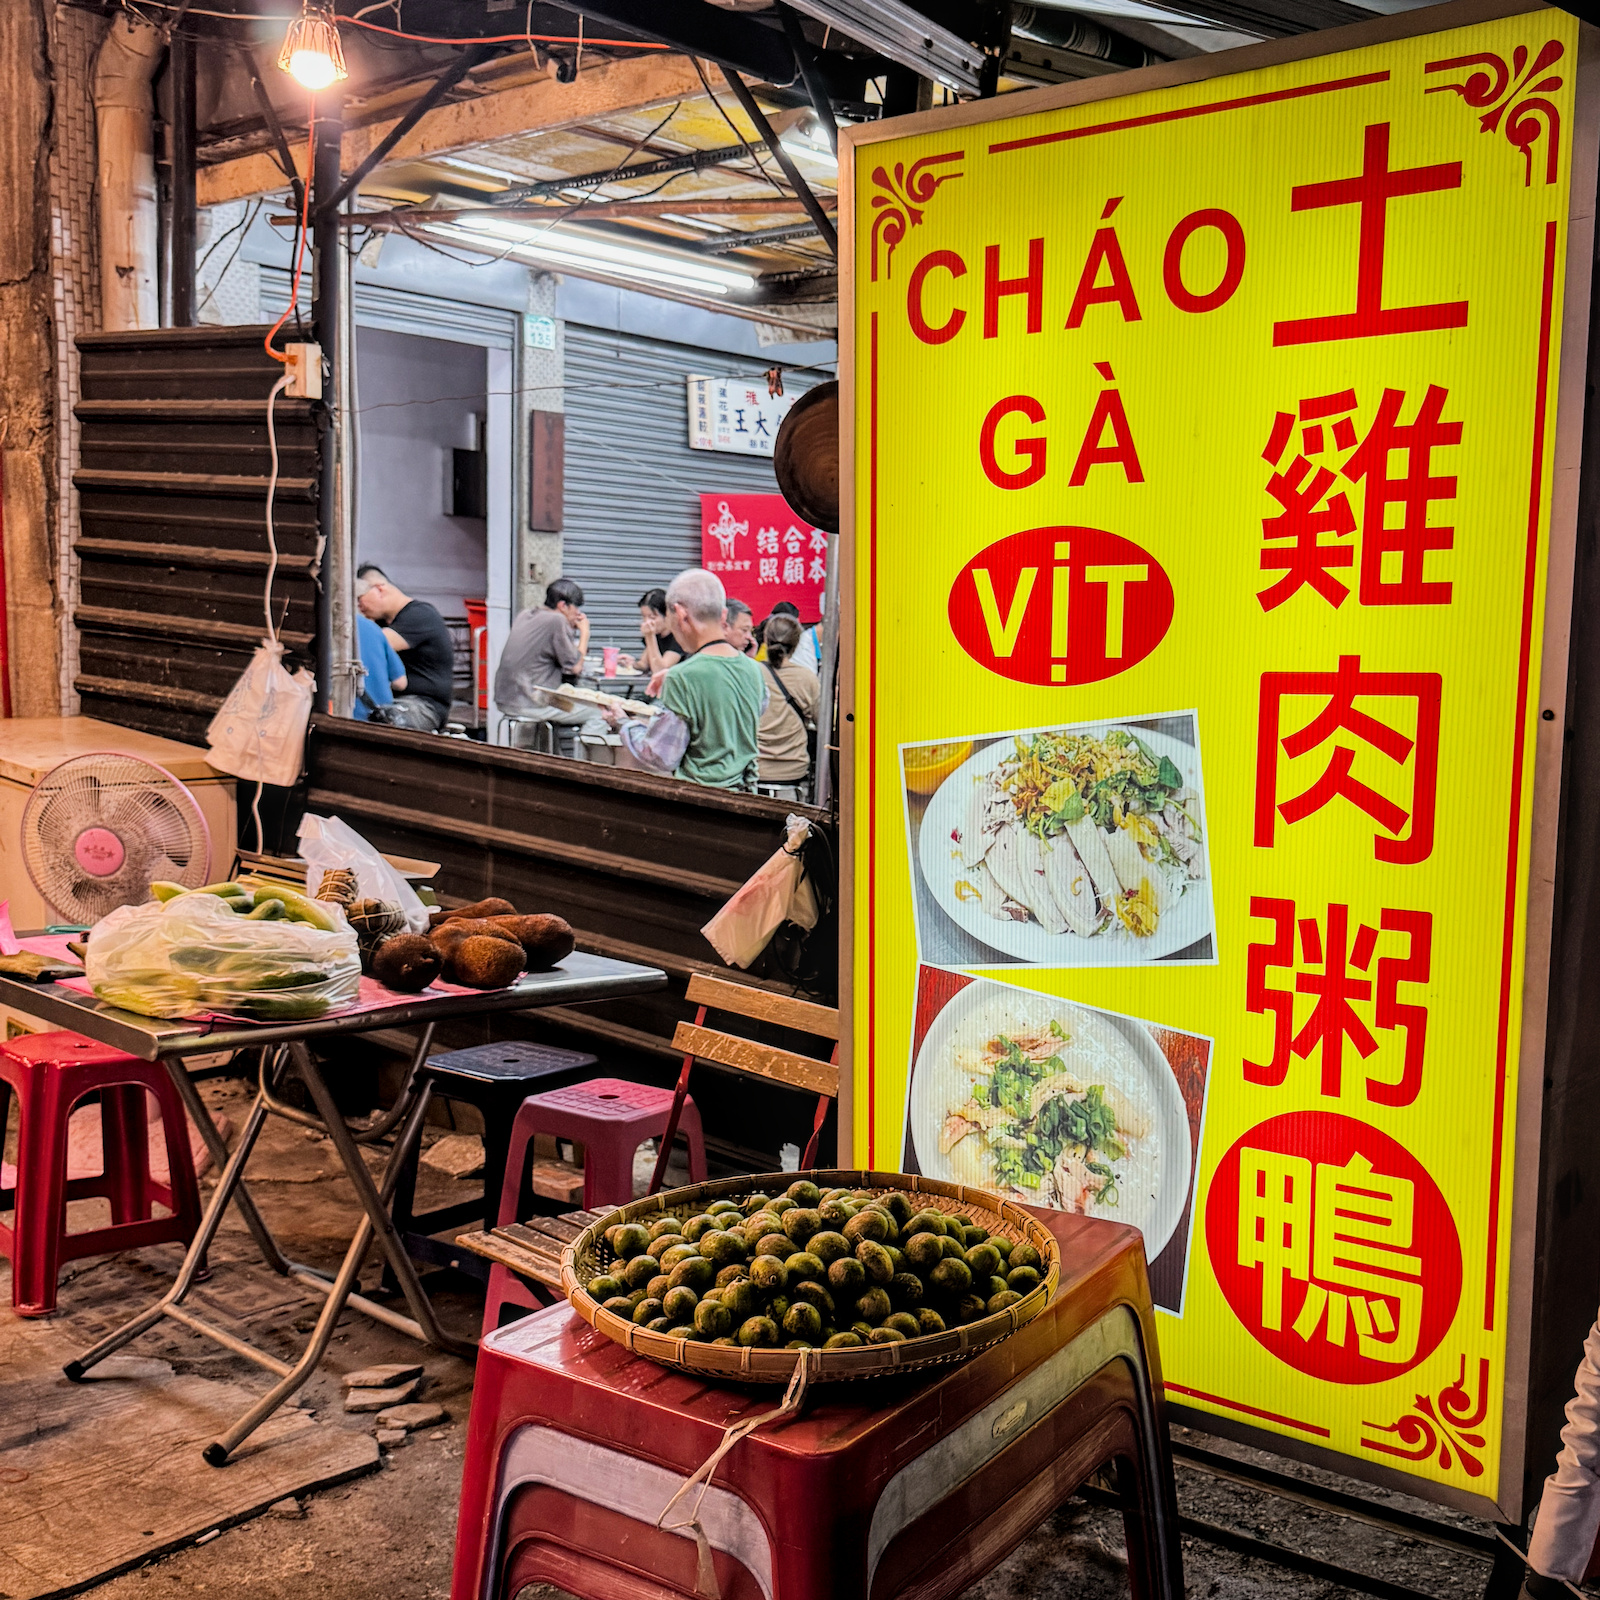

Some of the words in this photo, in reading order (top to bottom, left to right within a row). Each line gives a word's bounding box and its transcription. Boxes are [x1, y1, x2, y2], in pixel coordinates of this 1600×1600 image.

[907, 195, 1246, 345] CHÁO
[530, 332, 552, 346] 135
[734, 408, 782, 437] 王大
[979, 361, 1145, 490] GÀ
[756, 525, 828, 555] 結合本
[757, 556, 827, 585] 照顧本
[971, 541, 1149, 682] VỊT
